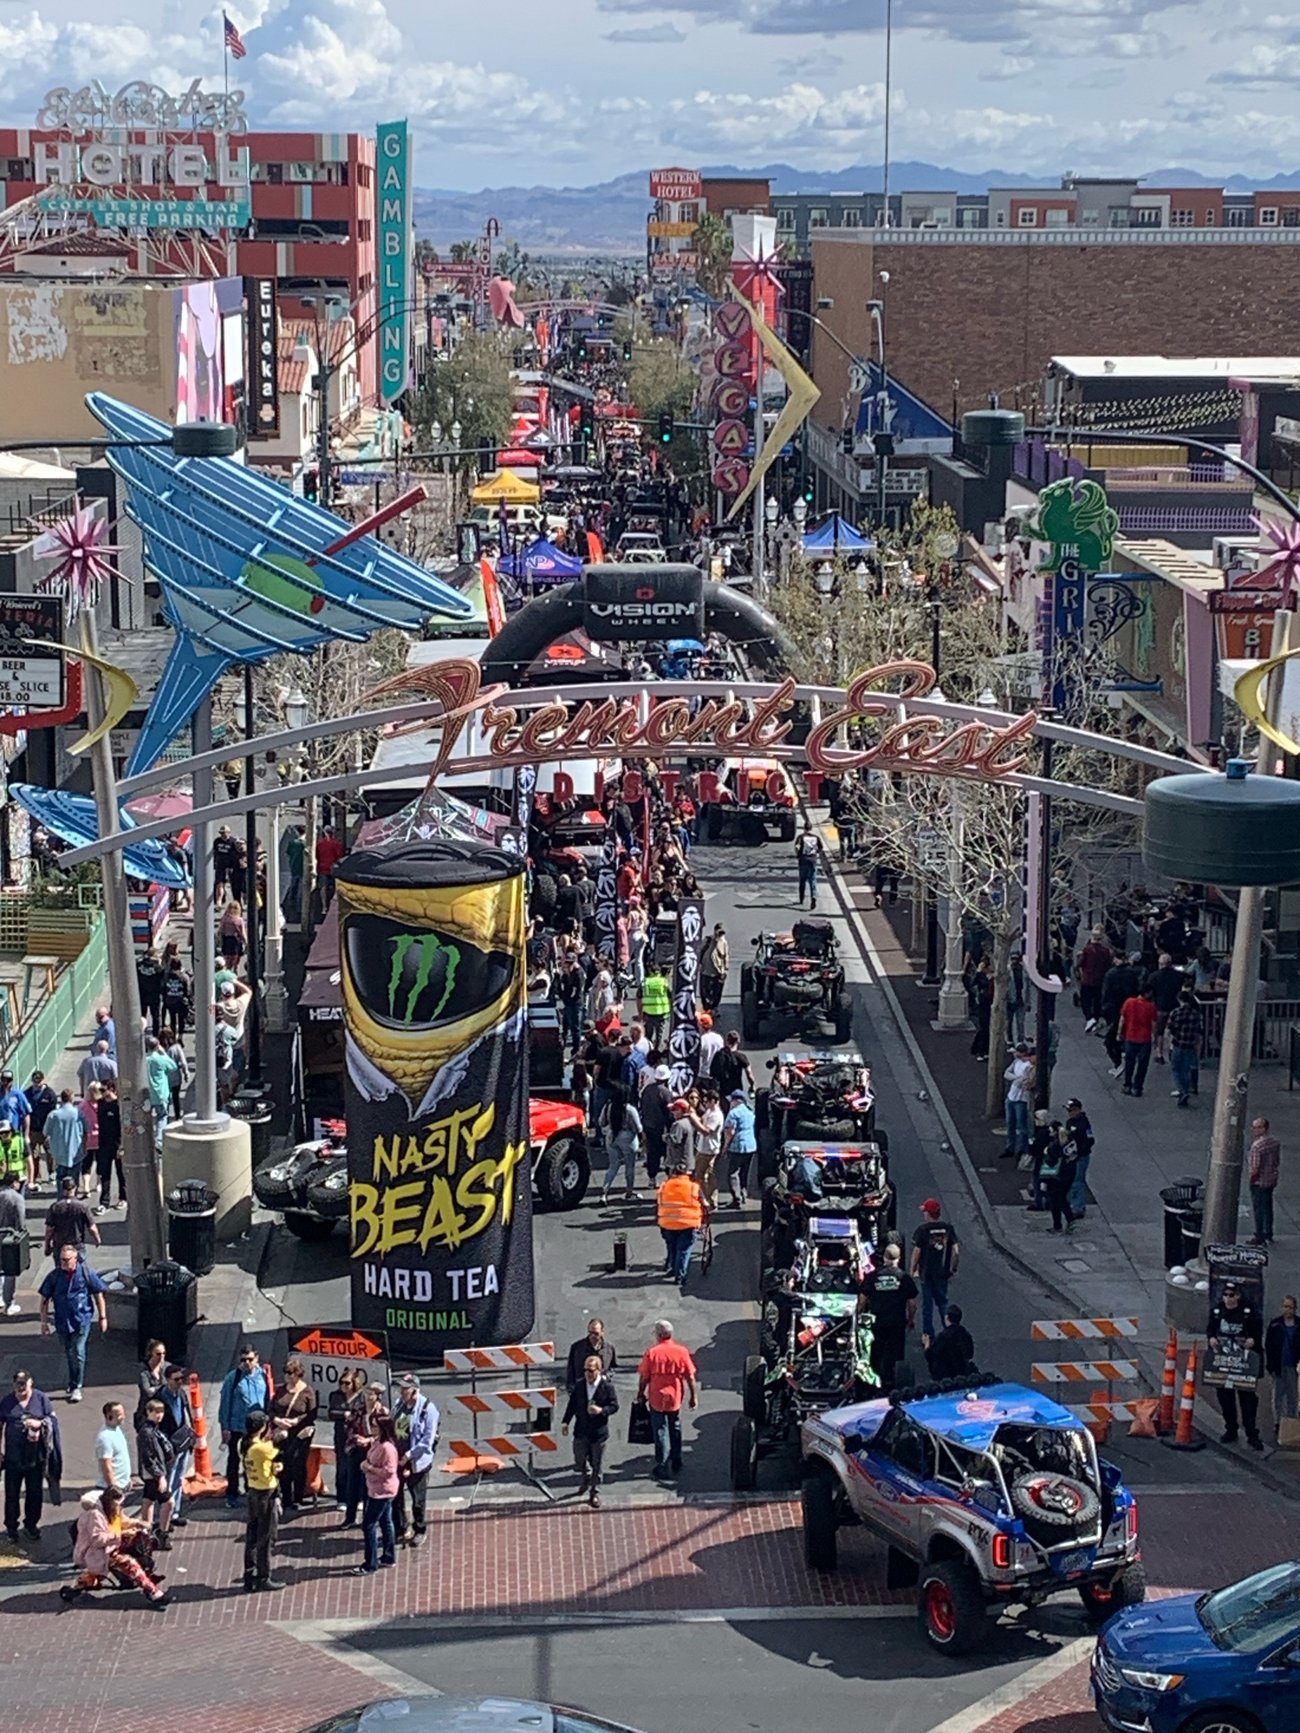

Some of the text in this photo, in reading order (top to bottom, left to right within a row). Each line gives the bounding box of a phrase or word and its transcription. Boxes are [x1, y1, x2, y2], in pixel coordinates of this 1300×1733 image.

[34, 142, 250, 187] HOTEL
[651, 170, 700, 183] WESTERN
[656, 185, 696, 198] HOTEL
[48, 199, 240, 214] COFFEE SHOP & BAR
[104, 211, 238, 228] FREE PARKING
[382, 132, 402, 383] GAMBLING
[259, 280, 273, 397] Eureka
[718, 308, 748, 494] VEGAS
[1060, 543, 1080, 558] THE
[591, 603, 696, 617] VISION
[2, 660, 26, 671] BEER
[20, 681, 49, 692] SLICE
[352, 657, 1039, 800] Fremont East
[553, 771, 826, 803] DISTRICT
[373, 1102, 496, 1183] NASTY
[348, 1139, 526, 1259] BEAST
[364, 1262, 499, 1302] HARD TEA
[385, 1308, 473, 1331] ORIGINAL
[308, 1339, 368, 1357] DETOUR
[311, 1363, 368, 1387] ROD
